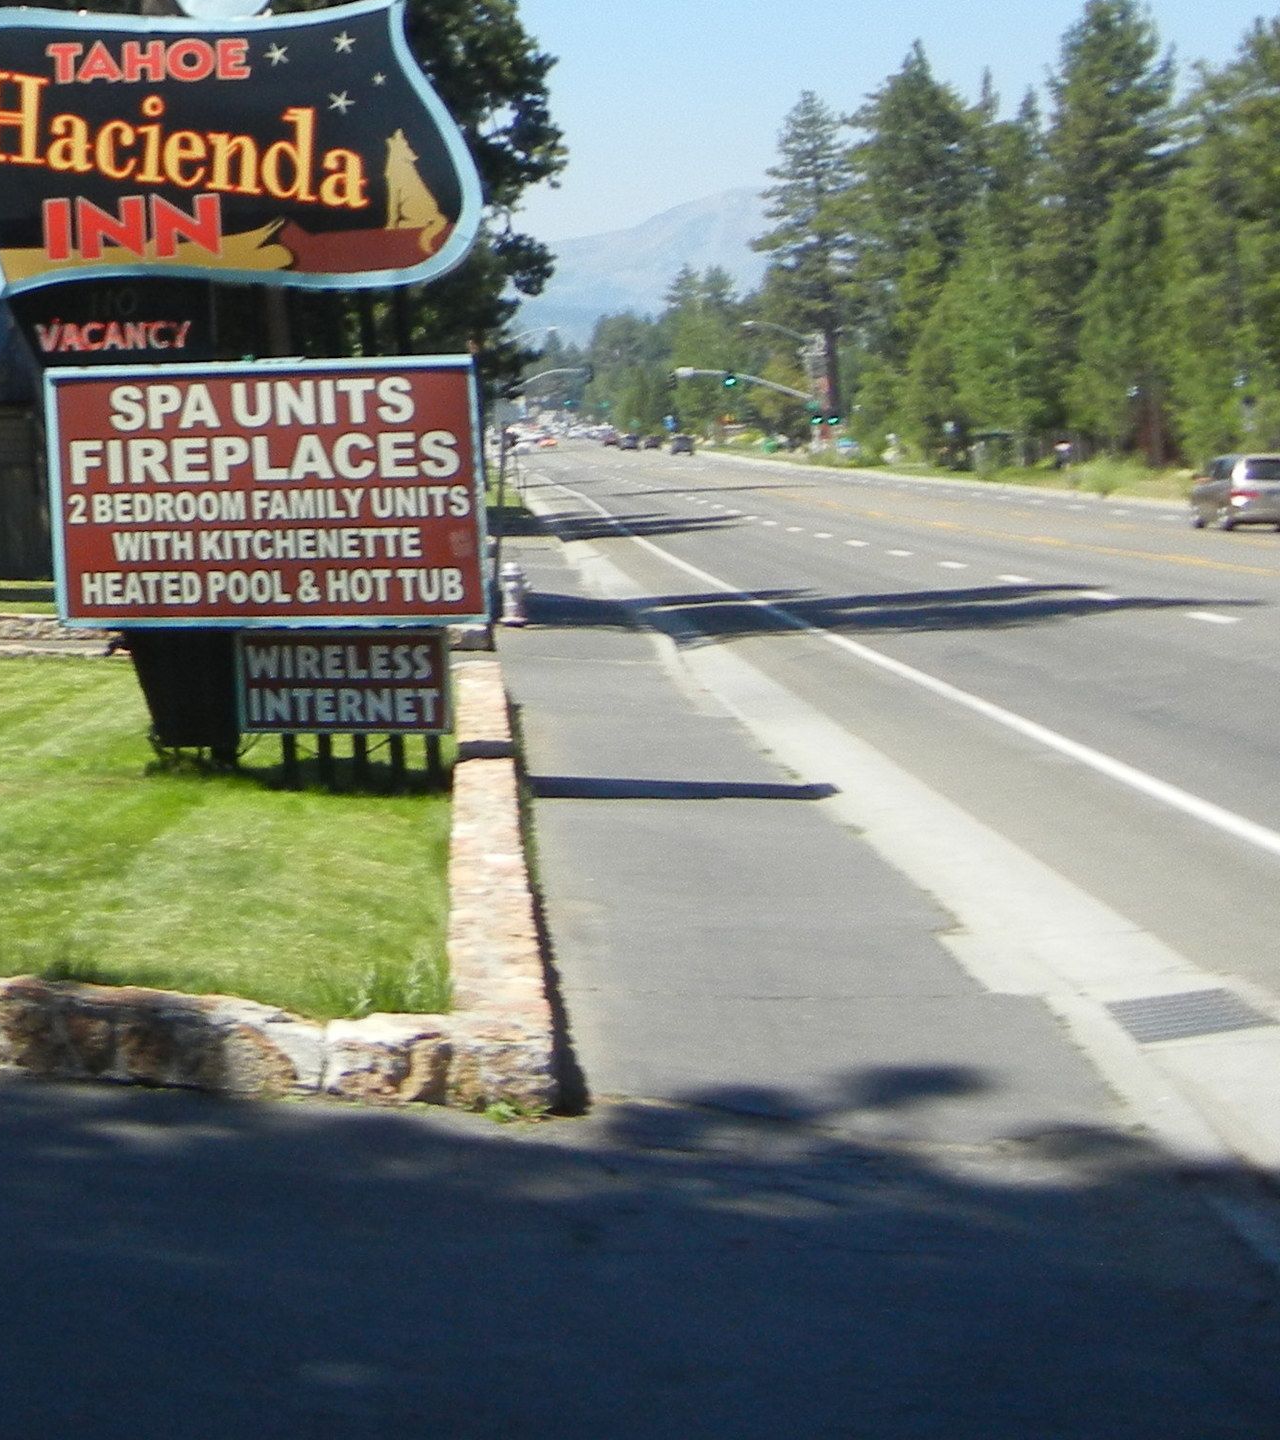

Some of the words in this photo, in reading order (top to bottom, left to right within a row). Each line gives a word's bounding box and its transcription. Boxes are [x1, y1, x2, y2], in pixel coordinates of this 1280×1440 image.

[46, 37, 252, 84] TAHOE
[42, 193, 223, 261] INN
[34, 319, 193, 353] VACANCY
[108, 383, 221, 432] SPA
[230, 376, 416, 428] UNITS
[68, 431, 461, 486] FIREPLACES
[67, 493, 88, 525] 2
[92, 490, 247, 525] BEDROOM
[252, 488, 365, 522] FAMILY
[370, 485, 471, 518] UNITS
[112, 530, 194, 562] WITH
[200, 527, 423, 561] KITCHENETTE
[80, 571, 202, 606] HEATED
[208, 570, 292, 605] POOL
[298, 570, 320, 603] &
[327, 569, 393, 603] HOT
[396, 568, 465, 603] TUB
[244, 644, 434, 682] WIRELESS
[249, 687, 439, 724] INTERNET
